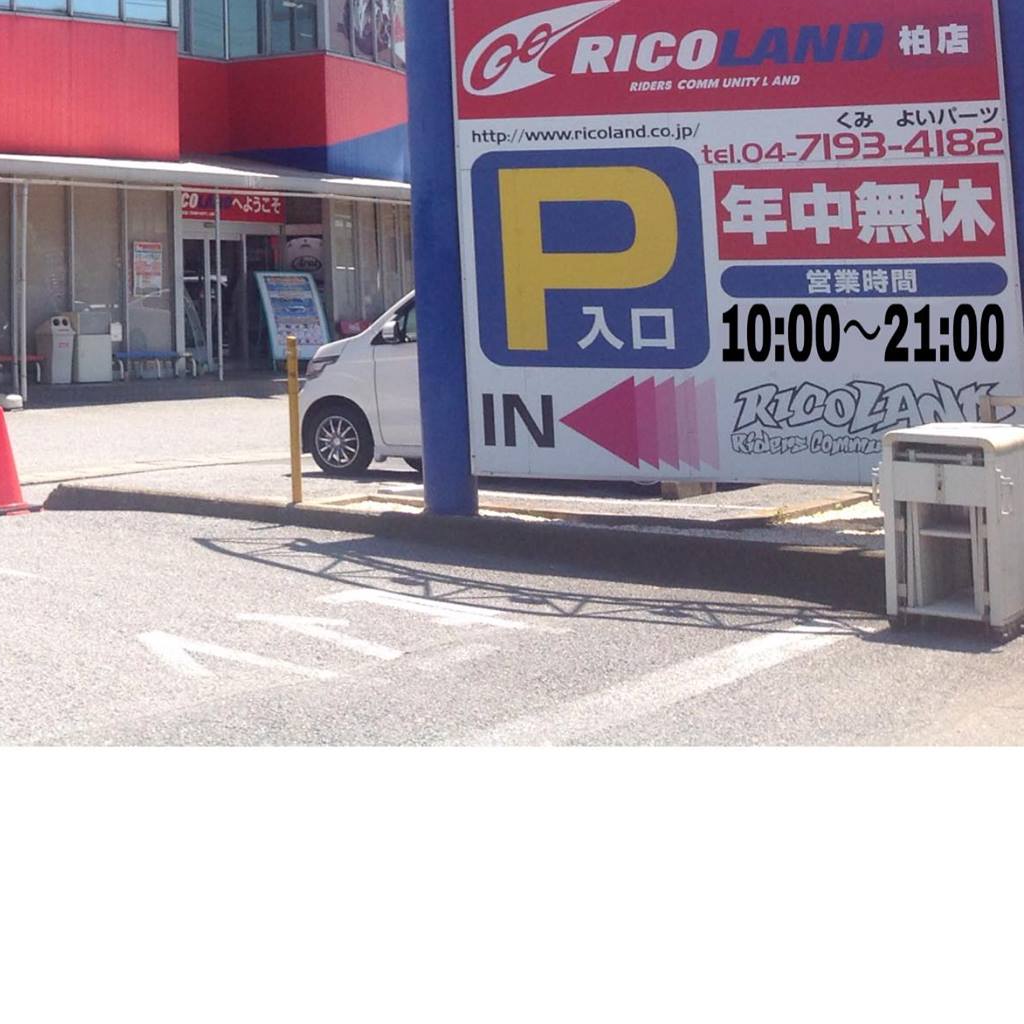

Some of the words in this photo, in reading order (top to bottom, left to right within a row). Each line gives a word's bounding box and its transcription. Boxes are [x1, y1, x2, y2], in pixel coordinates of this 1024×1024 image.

[571, 21, 884, 75] RICOLAND
[898, 22, 970, 56] 柏店
[629, 80, 673, 92] RIDERS
[471, 122, 701, 145] http://www.ricoland.co.jp/
[836, 111, 874, 129] くみ
[896, 105, 999, 127] よいパーツ
[720, 178, 996, 246] 年中無休
[498, 165, 678, 352] P
[805, 268, 918, 295] 営業時間
[576, 305, 676, 352] 入口
[482, 392, 557, 449] IN
